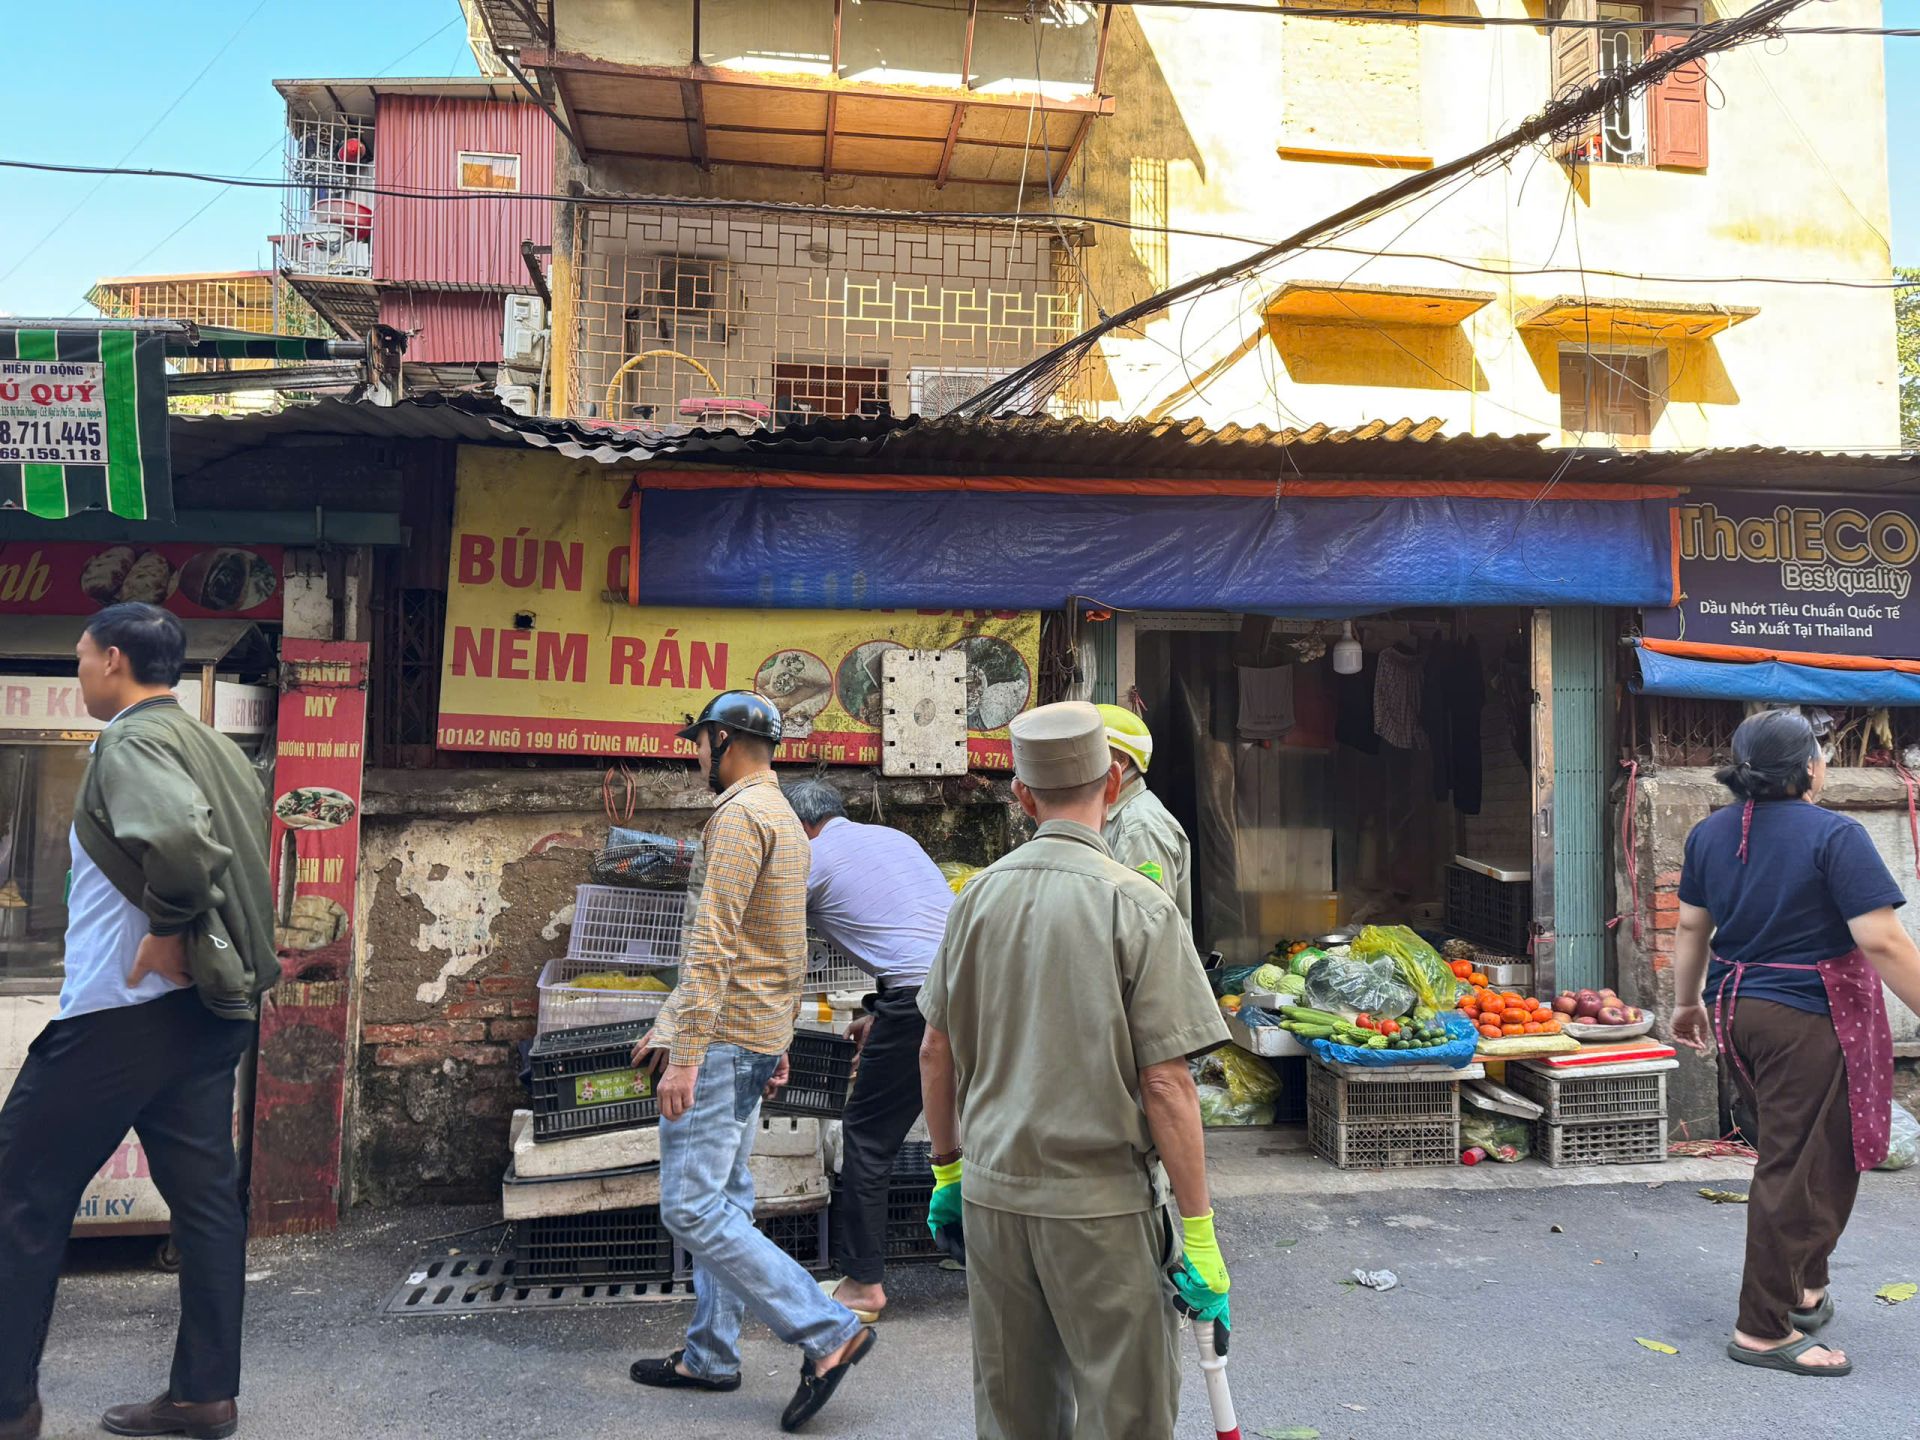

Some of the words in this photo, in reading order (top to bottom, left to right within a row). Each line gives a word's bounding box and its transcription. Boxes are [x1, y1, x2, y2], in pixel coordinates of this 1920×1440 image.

[3, 363, 31, 374] HIÊN
[34, 365, 46, 375] DI
[30, 380, 97, 406] QUÝ
[0, 420, 101, 446] 8.711.445
[0, 448, 101, 461] 69.159.118
[1680, 503, 1919, 566] ThaiECO
[458, 527, 584, 591] BÚN
[1783, 564, 1836, 591] Best
[1836, 566, 1911, 598] quality
[1700, 599, 1727, 615] Dầu
[1731, 602, 1766, 616] Nhớt
[1769, 603, 1798, 616] Tiêu
[1802, 602, 1843, 618] Chuẩn
[1847, 603, 1882, 619] Quốc
[1885, 605, 1900, 619] Tế
[1730, 620, 1755, 634] Sản
[1759, 621, 1790, 635] Xuất
[1793, 623, 1812, 638] Tại
[1815, 624, 1873, 638] Thailand
[451, 625, 589, 683] NEM
[609, 628, 729, 690] RÁN
[306, 742, 315, 759] VỊ
[438, 728, 485, 746] 101A2
[489, 727, 521, 748] NGÕ
[526, 731, 552, 748] 199
[582, 731, 621, 751] TÙNG
[625, 733, 659, 756] MẬU
[791, 740, 809, 758] TỪ
[858, 746, 878, 762] HN
[985, 752, 1009, 769] 374
[105, 1193, 135, 1216] KỲ
